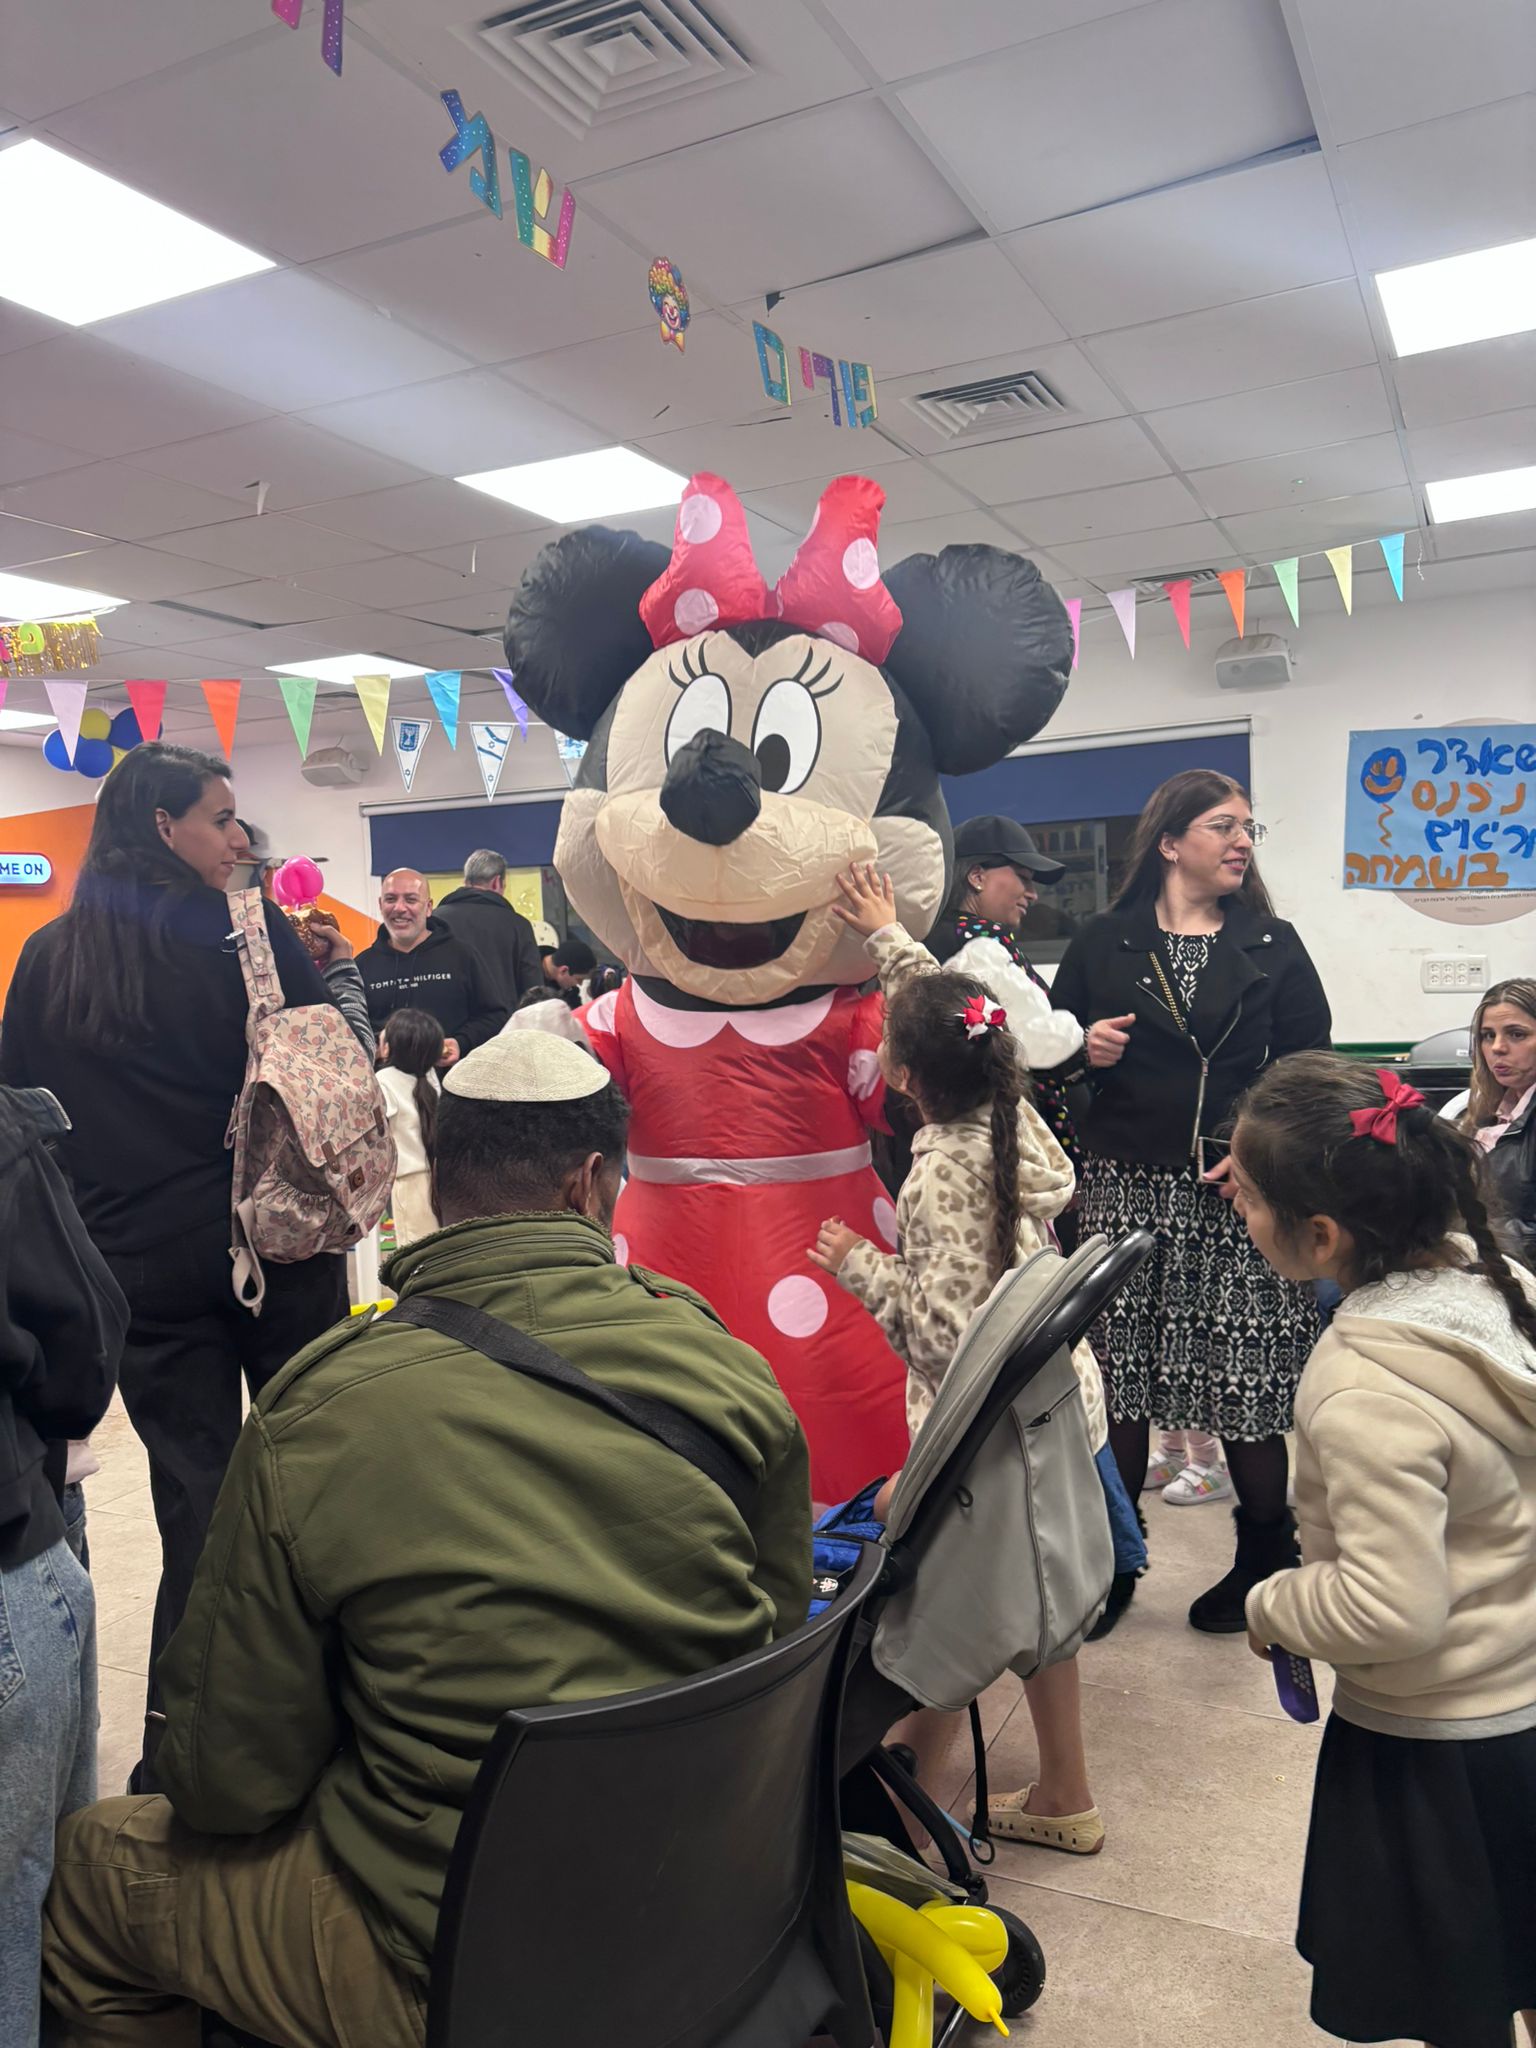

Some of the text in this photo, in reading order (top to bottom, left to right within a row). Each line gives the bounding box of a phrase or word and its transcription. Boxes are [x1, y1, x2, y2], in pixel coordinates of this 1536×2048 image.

[752, 320, 878, 428] פורים
[1411, 780, 1526, 817] נכנס
[23, 863, 43, 875] ON
[1346, 852, 1509, 888] בשמחה
[413, 973, 451, 982] HILFIGER
